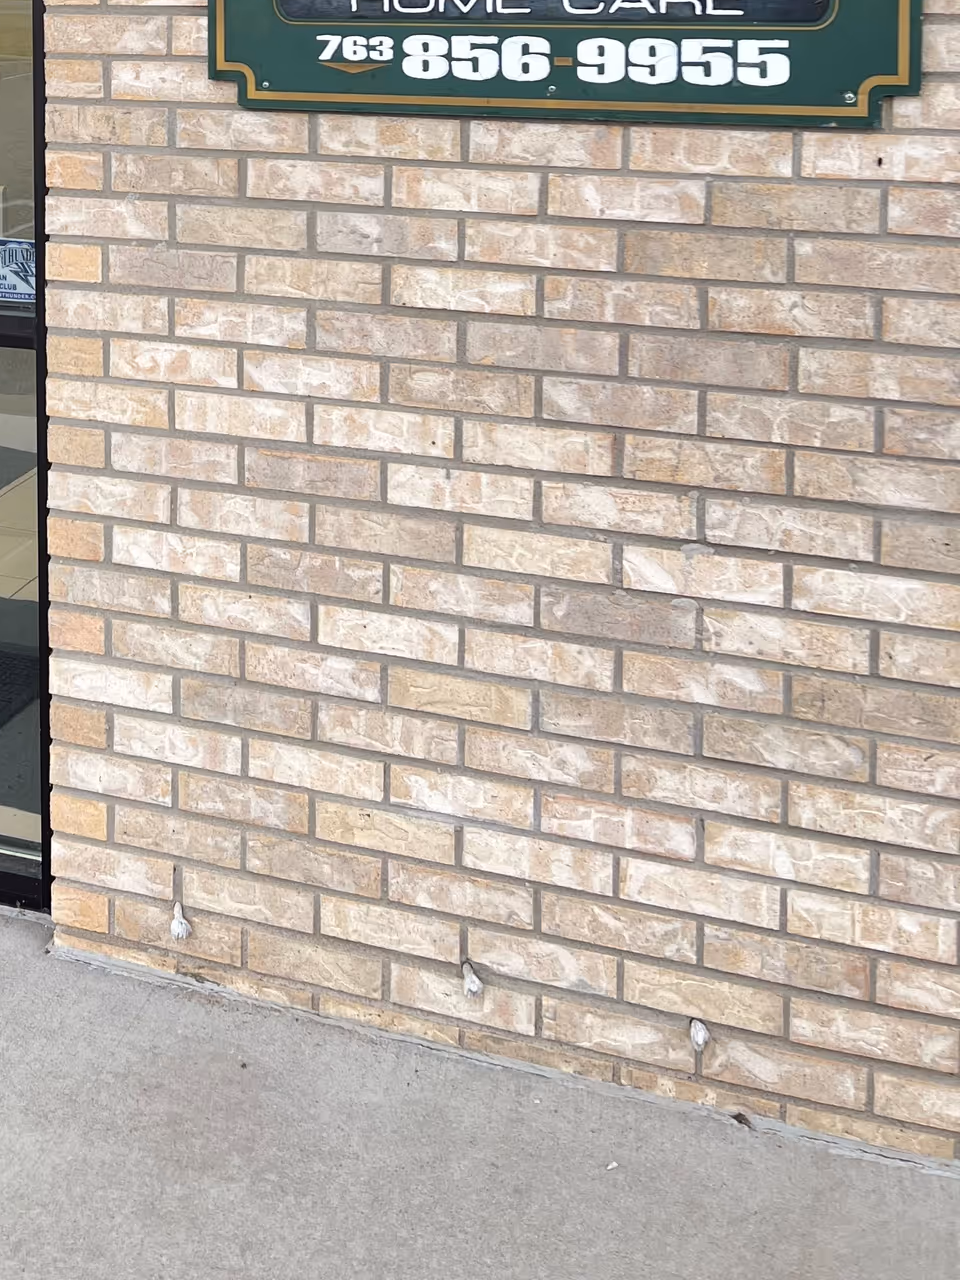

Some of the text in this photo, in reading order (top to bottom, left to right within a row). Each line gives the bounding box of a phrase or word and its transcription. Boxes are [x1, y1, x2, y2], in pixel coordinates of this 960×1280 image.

[316, 35, 791, 87] 763 856-9955
[0, 283, 17, 291] CLUB
